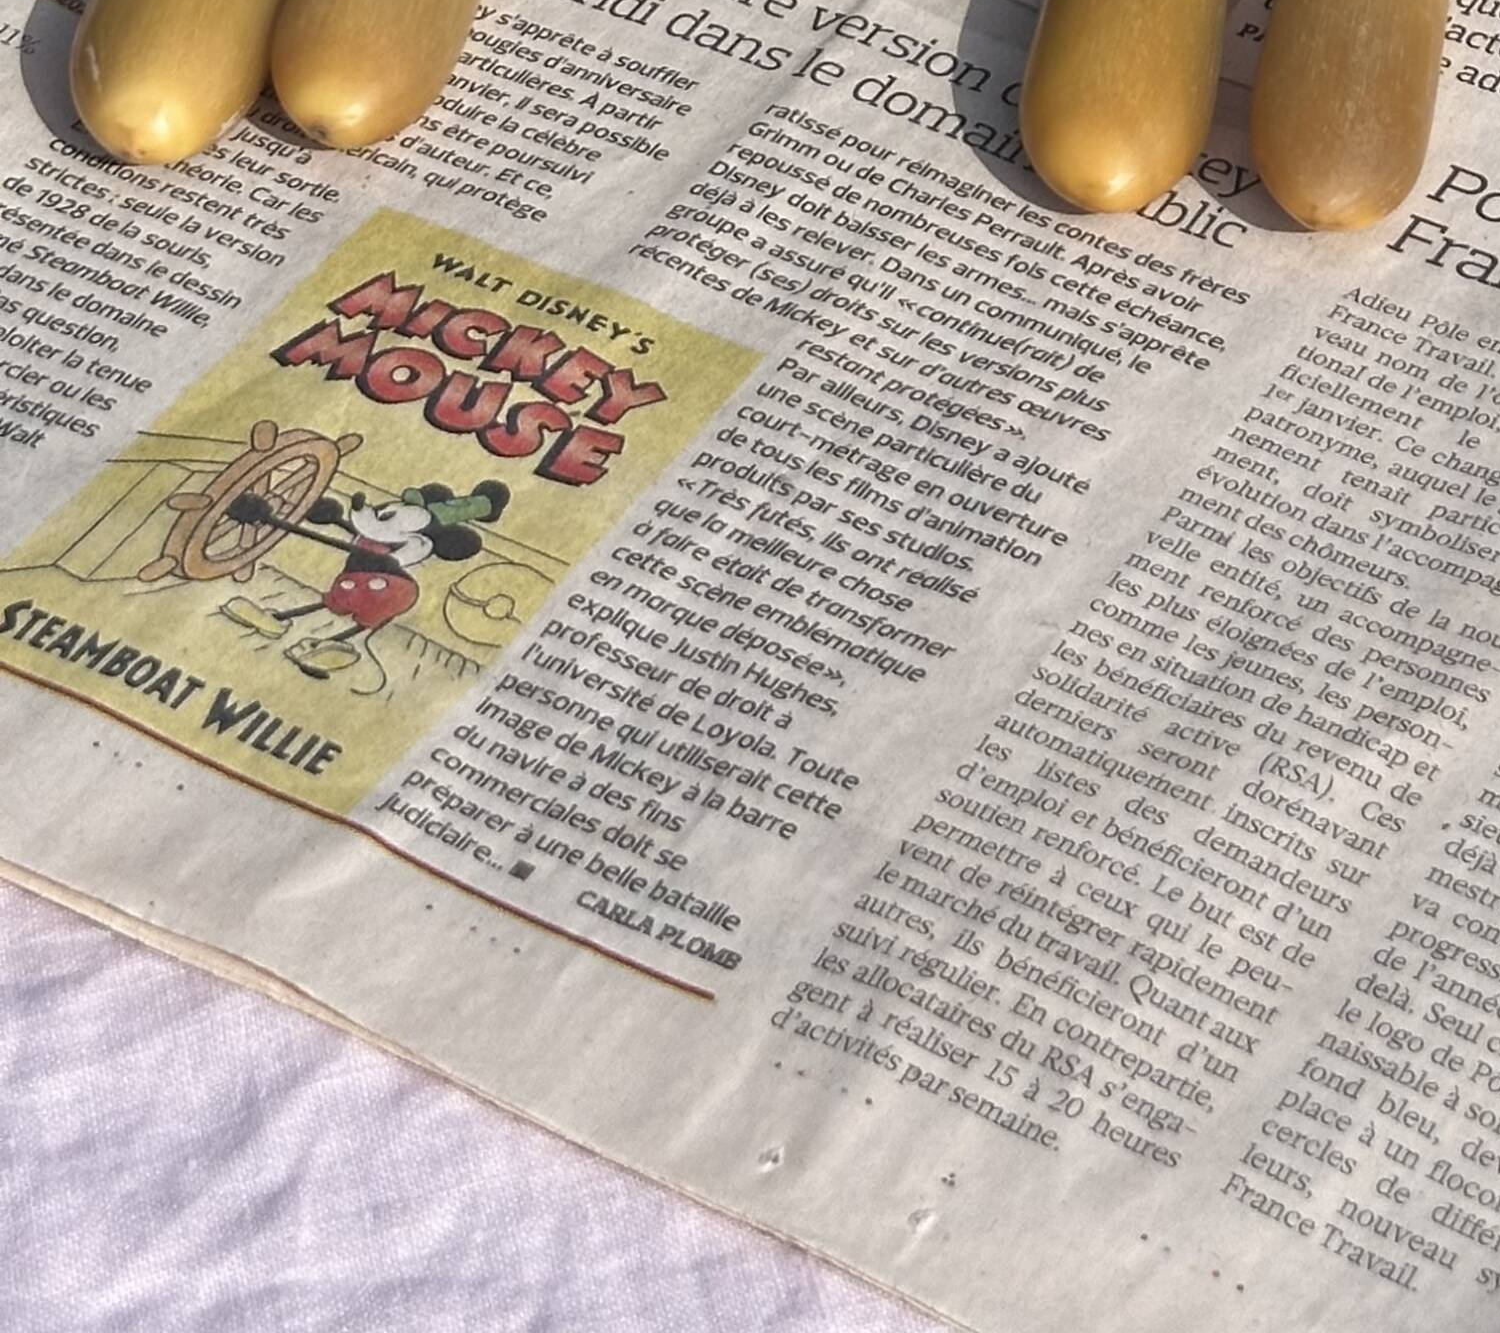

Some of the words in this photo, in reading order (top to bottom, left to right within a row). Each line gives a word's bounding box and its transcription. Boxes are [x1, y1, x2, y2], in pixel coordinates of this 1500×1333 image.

[494, 13, 597, 57] s'apprête
[596, 47, 613, 63] à
[613, 55, 700, 91] souffler
[542, 55, 692, 117] d'anniversaire
[665, 9, 797, 73] dans
[791, 47, 846, 88] le
[812, 4, 993, 97] version
[578, 91, 600, 110] À
[595, 102, 663, 130] partir
[2, 176, 34, 198] de
[35, 189, 92, 220] 1928
[87, 212, 120, 232] de
[117, 220, 142, 239] la
[140, 233, 212, 270] souris,
[48, 137, 161, 190] conditions
[157, 182, 244, 221] restent
[242, 212, 291, 240] très
[763, 103, 844, 141] ratissé
[838, 134, 898, 161] pour
[895, 156, 1017, 213] réimaginer
[1015, 203, 1053, 228] les
[1053, 222, 1133, 260] contes
[1133, 253, 1177, 278] des
[1178, 268, 1251, 305] frères
[22, 245, 151, 300] Steamboat
[149, 289, 211, 329] Willie,
[431, 252, 509, 295] WALT
[514, 285, 658, 358] DISNEY'S
[707, 160, 787, 199] Disney
[786, 193, 833, 221] doit
[831, 210, 917, 251] baisser
[915, 242, 952, 268] les
[1042, 297, 1100, 327] mais
[1099, 321, 1211, 371] s'apprête
[1342, 287, 1412, 322] Adieu
[1418, 313, 1470, 342] Pôle
[329, 271, 668, 425] MICKEY
[1326, 303, 1408, 345] France
[1412, 333, 1496, 379] Travail.
[268, 317, 625, 488] MOUSE
[776, 356, 821, 384] Par
[819, 378, 904, 426] ailleurs,
[909, 414, 994, 457] Disney
[992, 447, 1011, 463] a
[1011, 454, 1090, 495] ajouté
[0, 599, 204, 709] STEAMBOAT
[201, 686, 344, 779] WILLIE
[520, 641, 657, 713] l'université
[655, 702, 691, 727] de
[690, 713, 777, 760] Loyola.
[787, 746, 860, 791] Toute
[475, 695, 554, 742] image
[553, 731, 588, 757] de
[587, 743, 682, 796] Mickey
[681, 782, 701, 803] à
[699, 786, 726, 811] la
[725, 795, 798, 841] barre
[576, 890, 655, 937] CARLA
[654, 923, 743, 971] PLOMB
[770, 1006, 903, 1072] d'activités
[897, 1062, 951, 1096] par
[947, 1086, 1059, 1152] semaine.
[786, 981, 853, 1015] gent
[855, 999, 874, 1023] à
[879, 1012, 981, 1070] réaliser
[983, 1058, 1020, 1088] 15
[1021, 1076, 1041, 1103] à
[1047, 1088, 1085, 1119] 20
[1089, 1109, 1182, 1168] heures
[1219, 1171, 1316, 1237] France
[1320, 1222, 1419, 1293] Travail.
